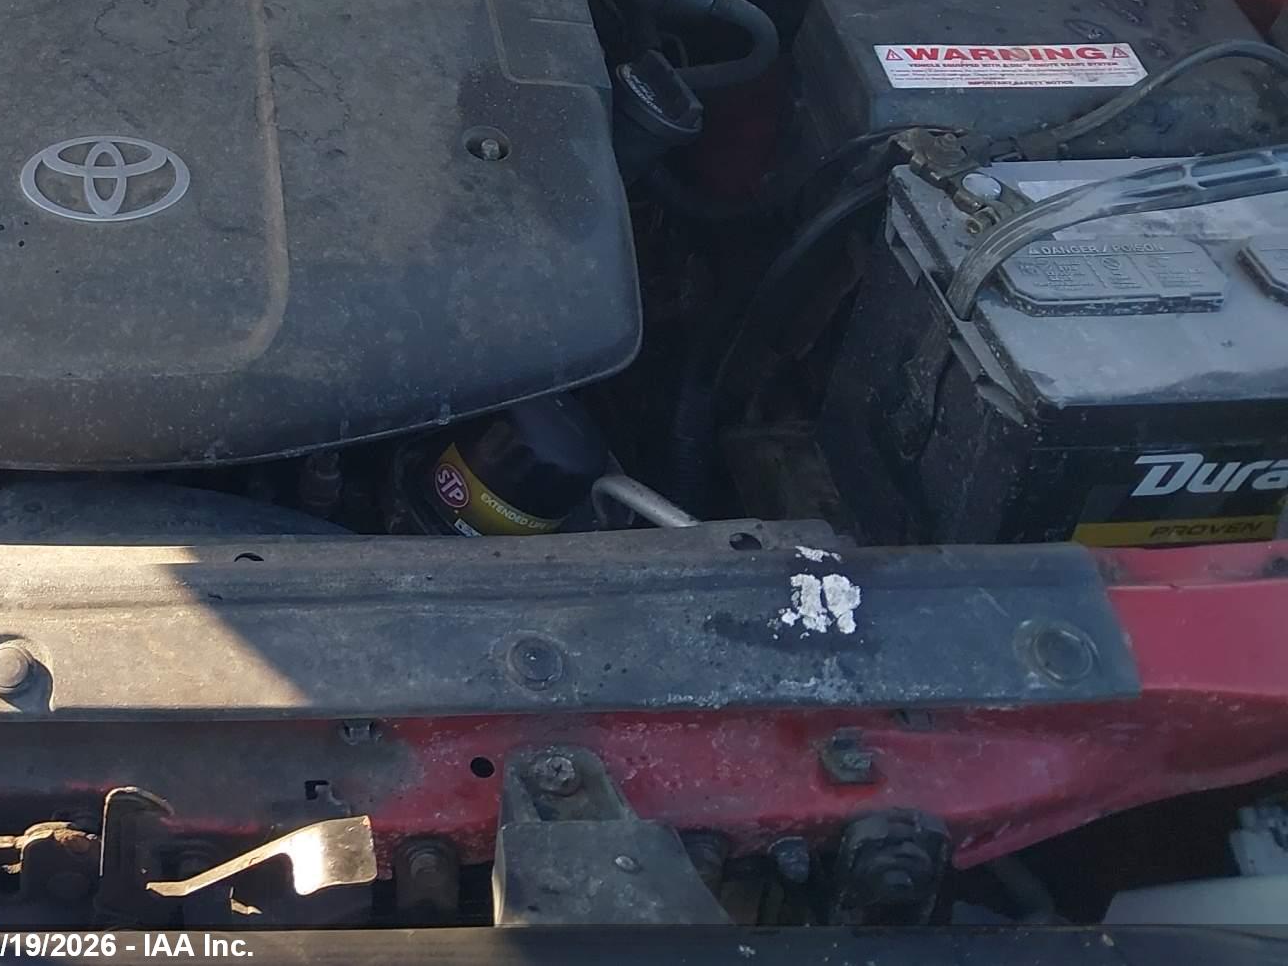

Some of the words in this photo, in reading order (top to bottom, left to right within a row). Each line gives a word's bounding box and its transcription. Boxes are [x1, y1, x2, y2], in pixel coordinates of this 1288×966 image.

[903, 47, 1107, 61] WARNING
[1040, 245, 1097, 255] DANGER
[1111, 243, 1165, 253] POISON
[437, 469, 466, 502] STP
[480, 492, 529, 526] EXTENDED
[1150, 521, 1262, 537] PROVEN
